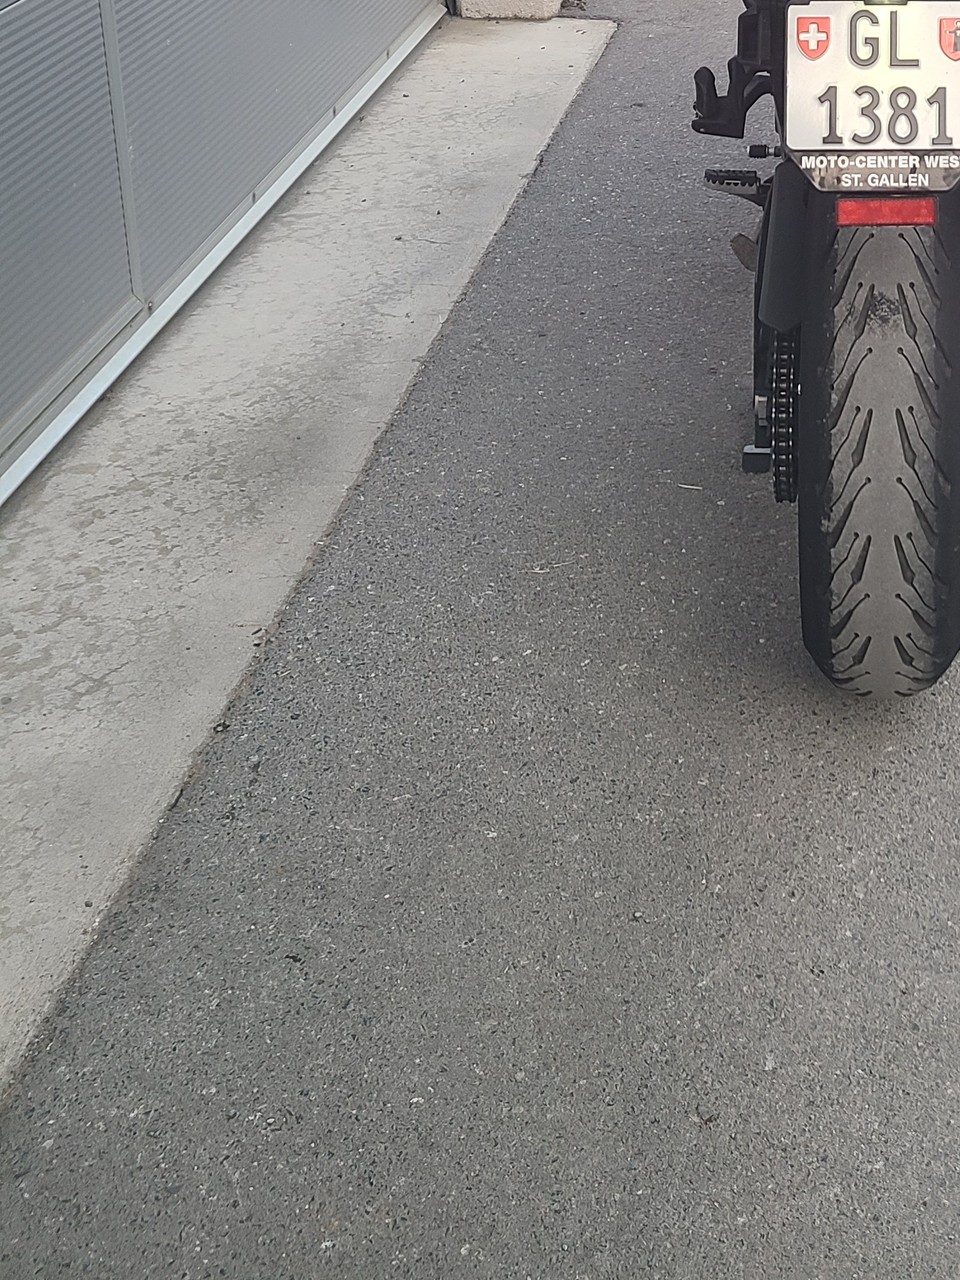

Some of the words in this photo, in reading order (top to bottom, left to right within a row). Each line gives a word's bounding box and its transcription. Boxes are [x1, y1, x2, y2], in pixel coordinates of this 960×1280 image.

[850, 10, 919, 66] GL
[817, 86, 953, 145] 1381
[801, 155, 920, 169] MOTO-CENTER
[841, 173, 863, 187] ST.
[867, 173, 929, 187] GALLEN
